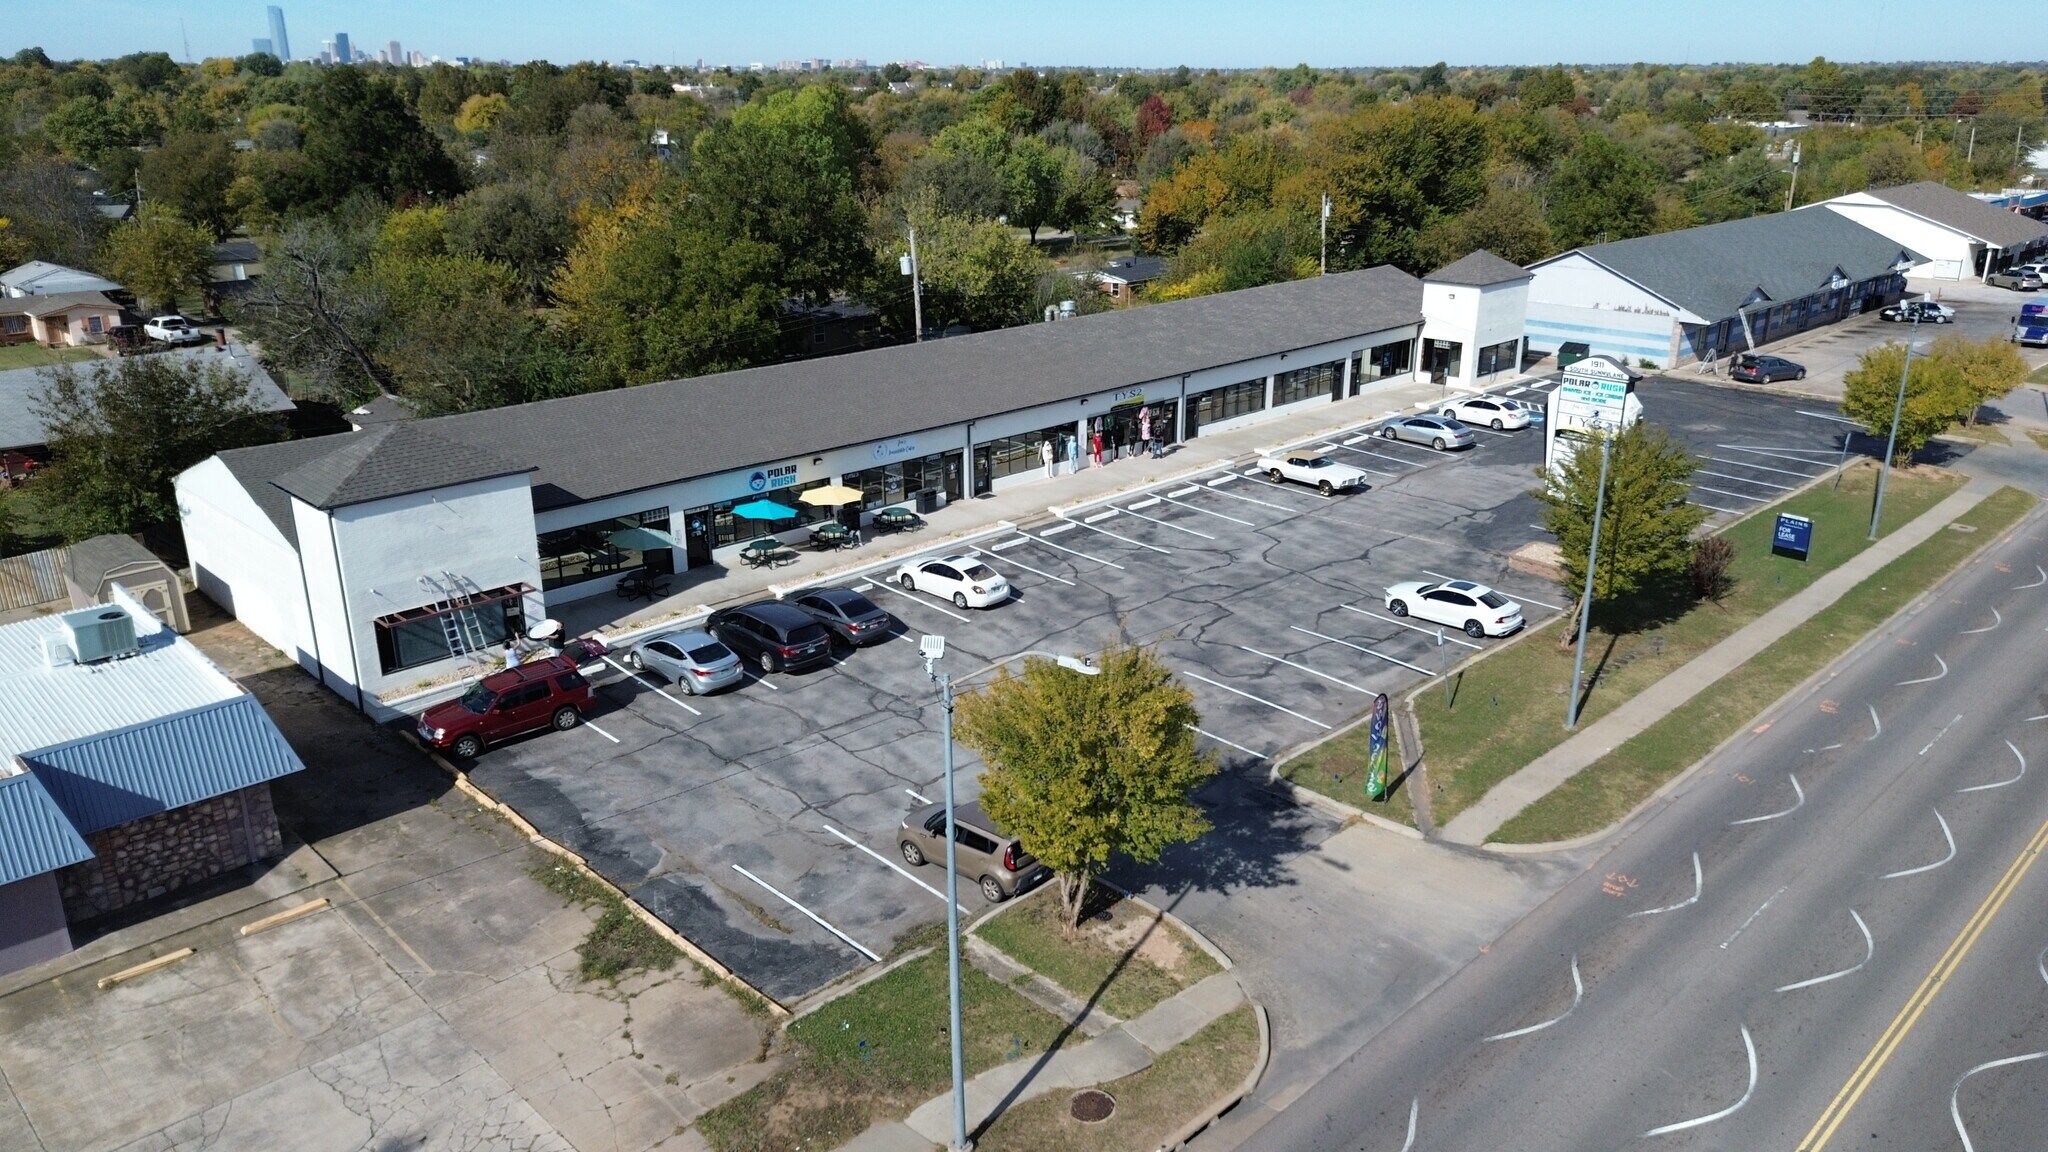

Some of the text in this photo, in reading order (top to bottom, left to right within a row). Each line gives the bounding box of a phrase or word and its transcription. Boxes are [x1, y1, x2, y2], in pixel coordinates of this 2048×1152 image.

[1569, 366, 1589, 374] SOUTH
[1591, 360, 1605, 369] 1911
[1563, 377, 1625, 393] POLAR RUSH
[767, 464, 797, 479] POLAR
[770, 474, 797, 488] RUSH
[1780, 517, 1809, 528] PLAINS
[1777, 531, 1796, 540] LEASE
